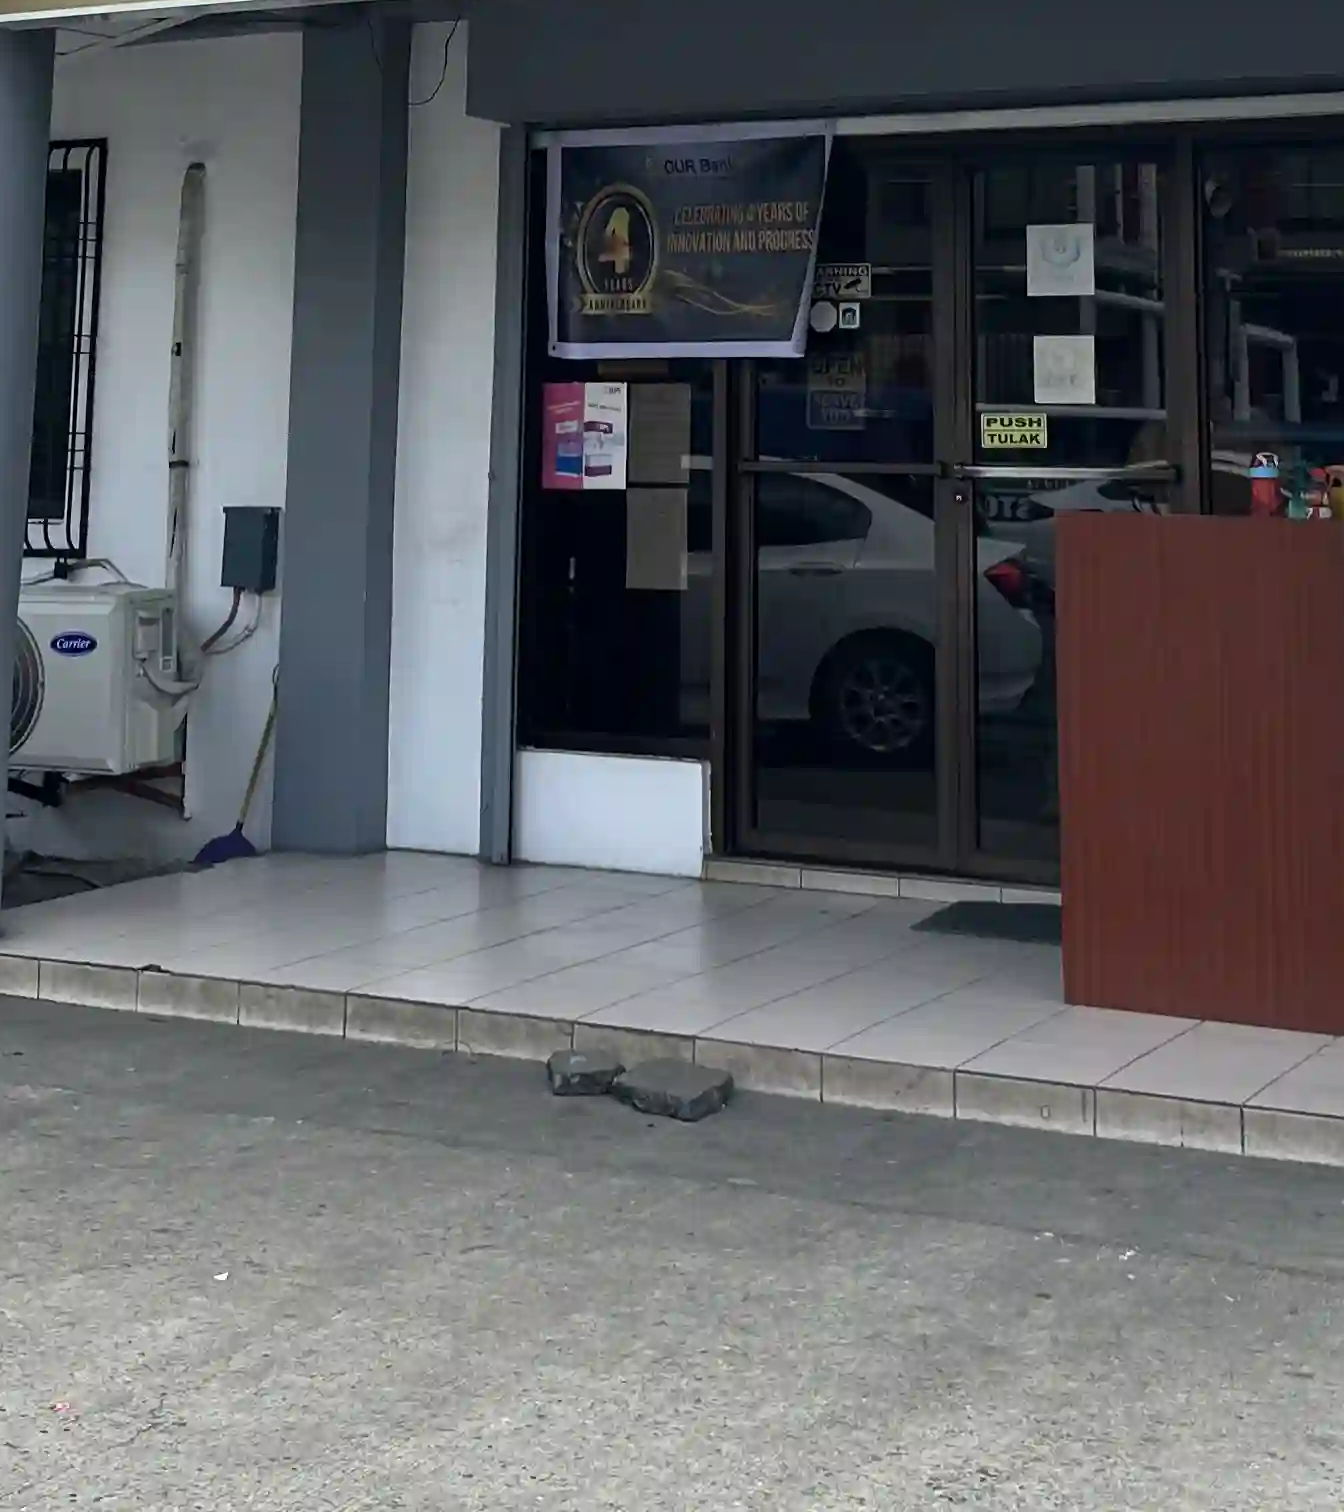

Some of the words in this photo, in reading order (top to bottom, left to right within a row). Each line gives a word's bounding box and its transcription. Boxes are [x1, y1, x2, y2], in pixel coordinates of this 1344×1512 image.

[664, 159, 697, 175] OUR
[757, 202, 794, 223] YEARS
[667, 231, 730, 254] INNOVATION
[816, 266, 868, 278] ARNING
[813, 283, 842, 296] CTV
[985, 416, 1042, 429] PUSH
[987, 432, 1041, 445] TULAK
[56, 638, 91, 650] Carrier
